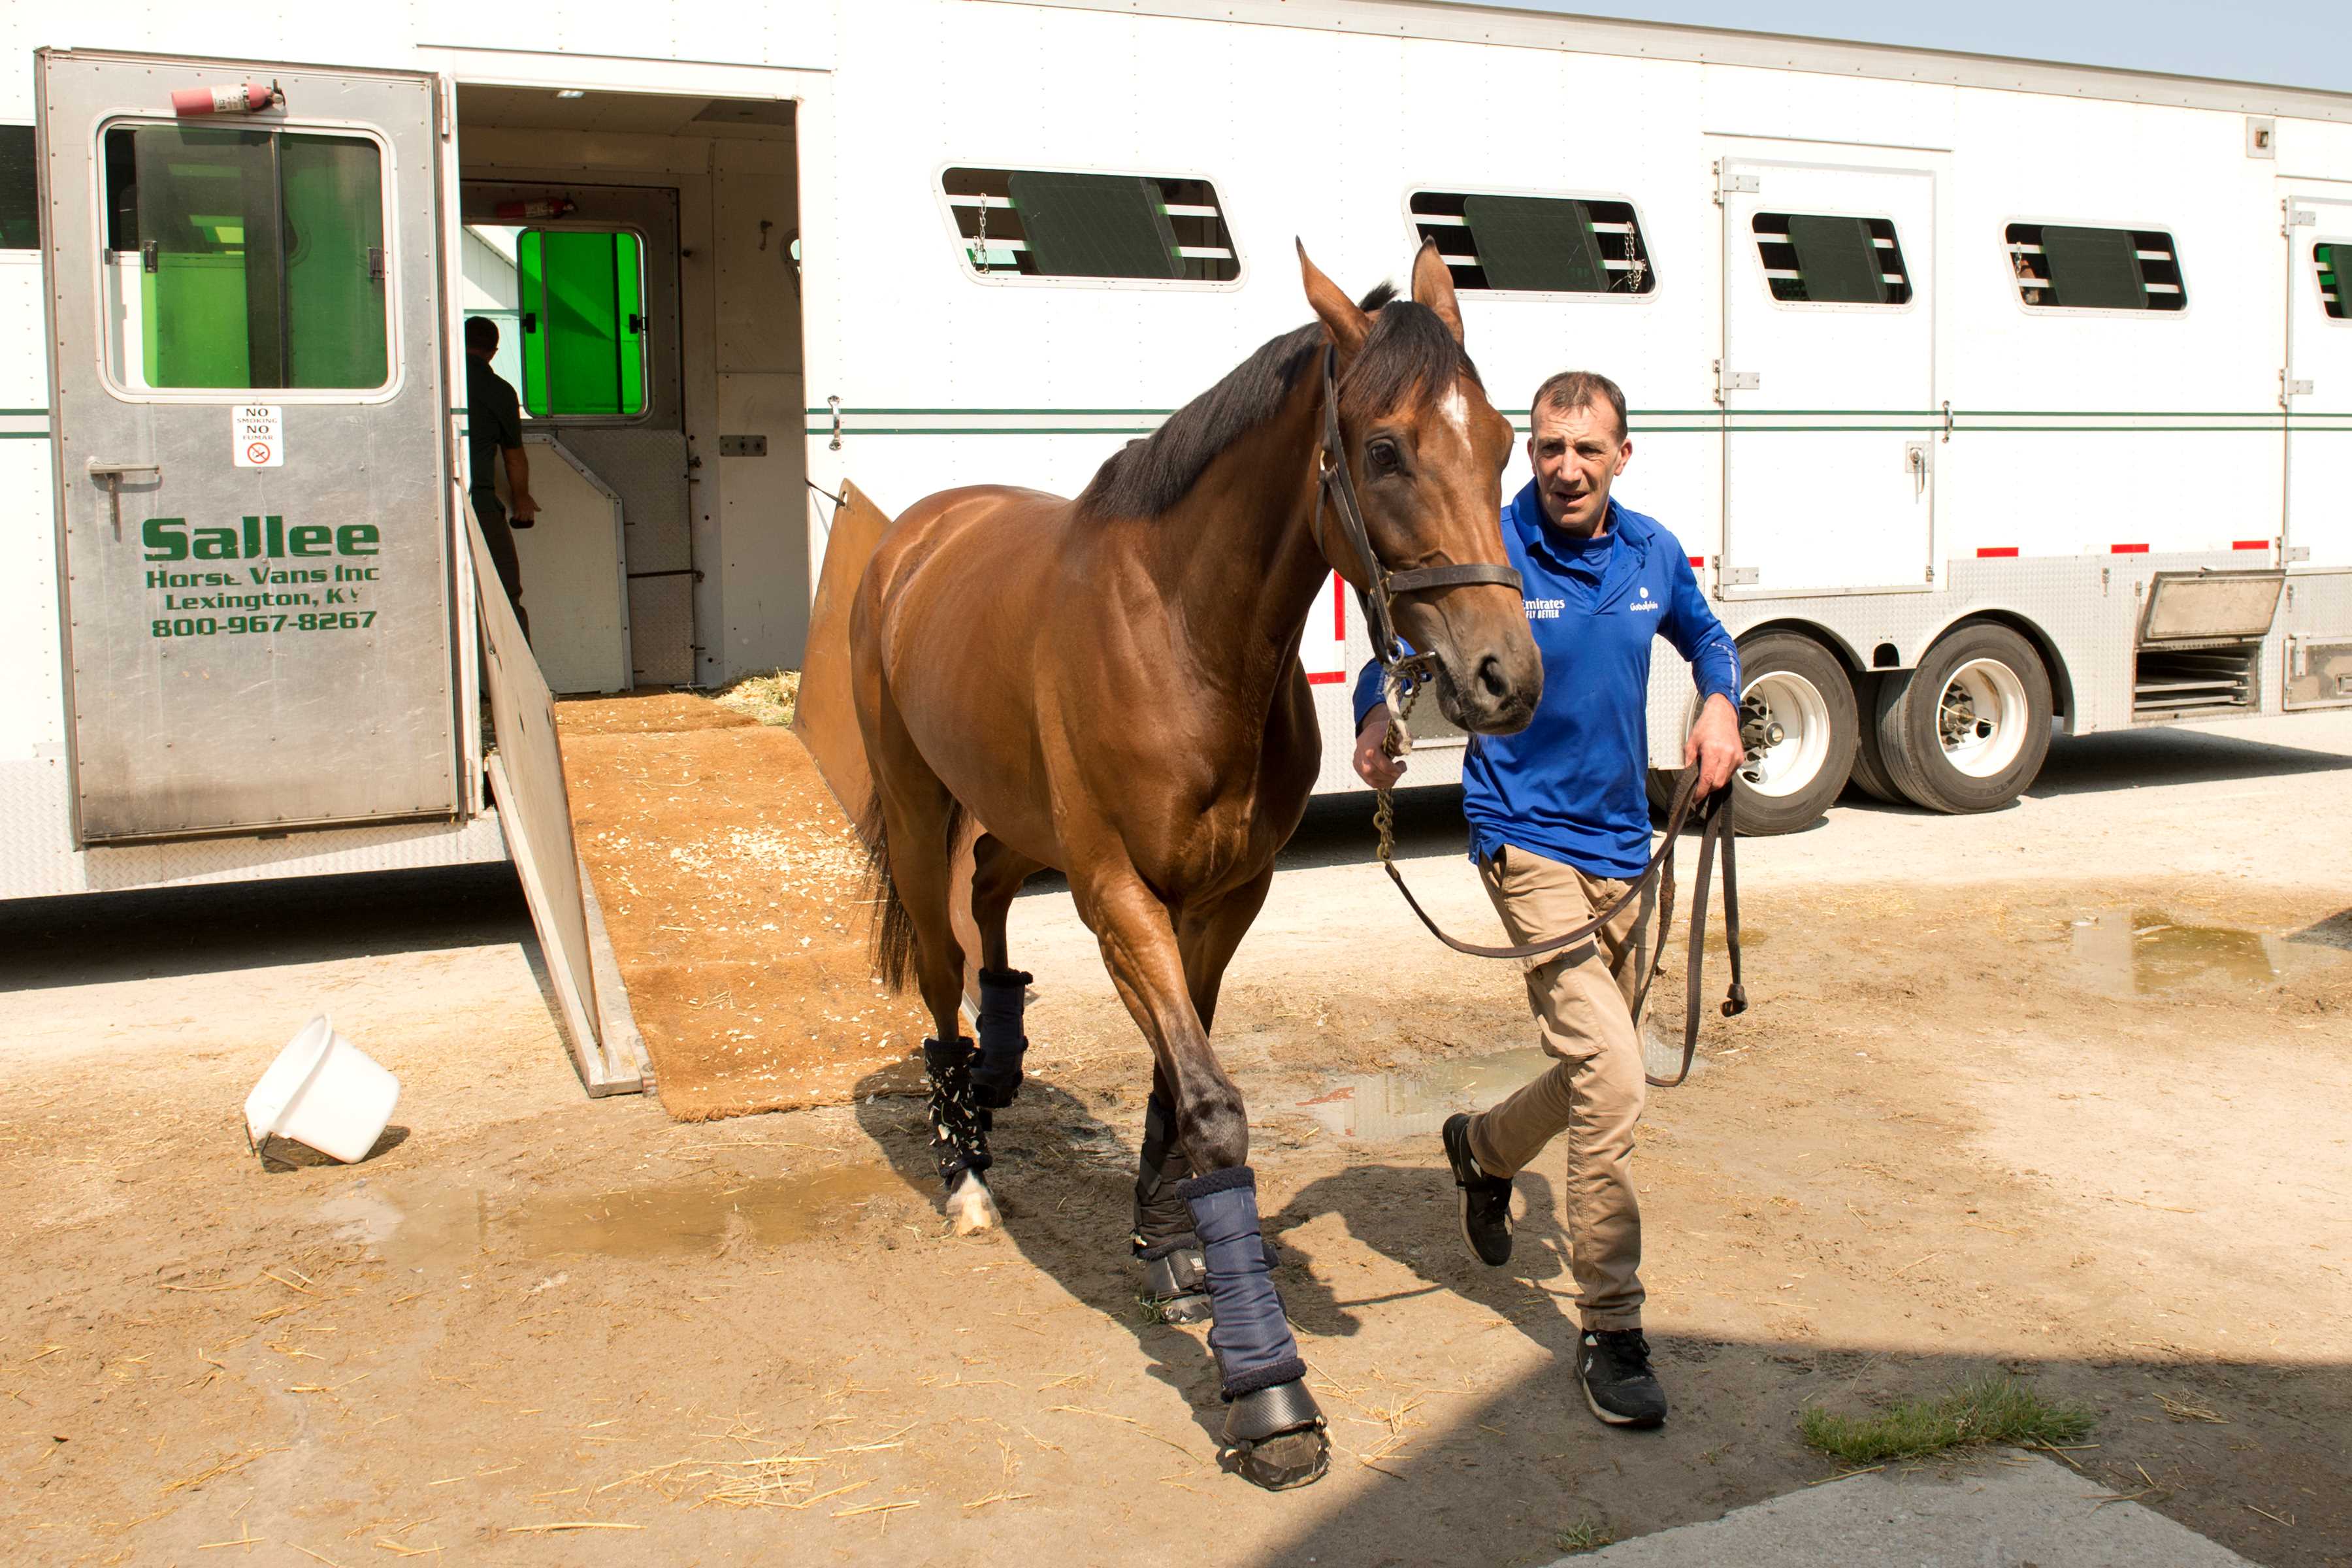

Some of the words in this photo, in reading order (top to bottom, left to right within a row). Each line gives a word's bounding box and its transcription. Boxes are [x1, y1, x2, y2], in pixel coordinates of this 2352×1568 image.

[246, 408, 269, 417] NO
[246, 425, 269, 434] NO
[142, 515, 380, 562] Sallee
[249, 566, 328, 585] Vans
[334, 564, 380, 582] Inc
[165, 591, 319, 612] Lexington,
[1522, 597, 1566, 610] mirates
[151, 610, 378, 638] 800-967-8267
